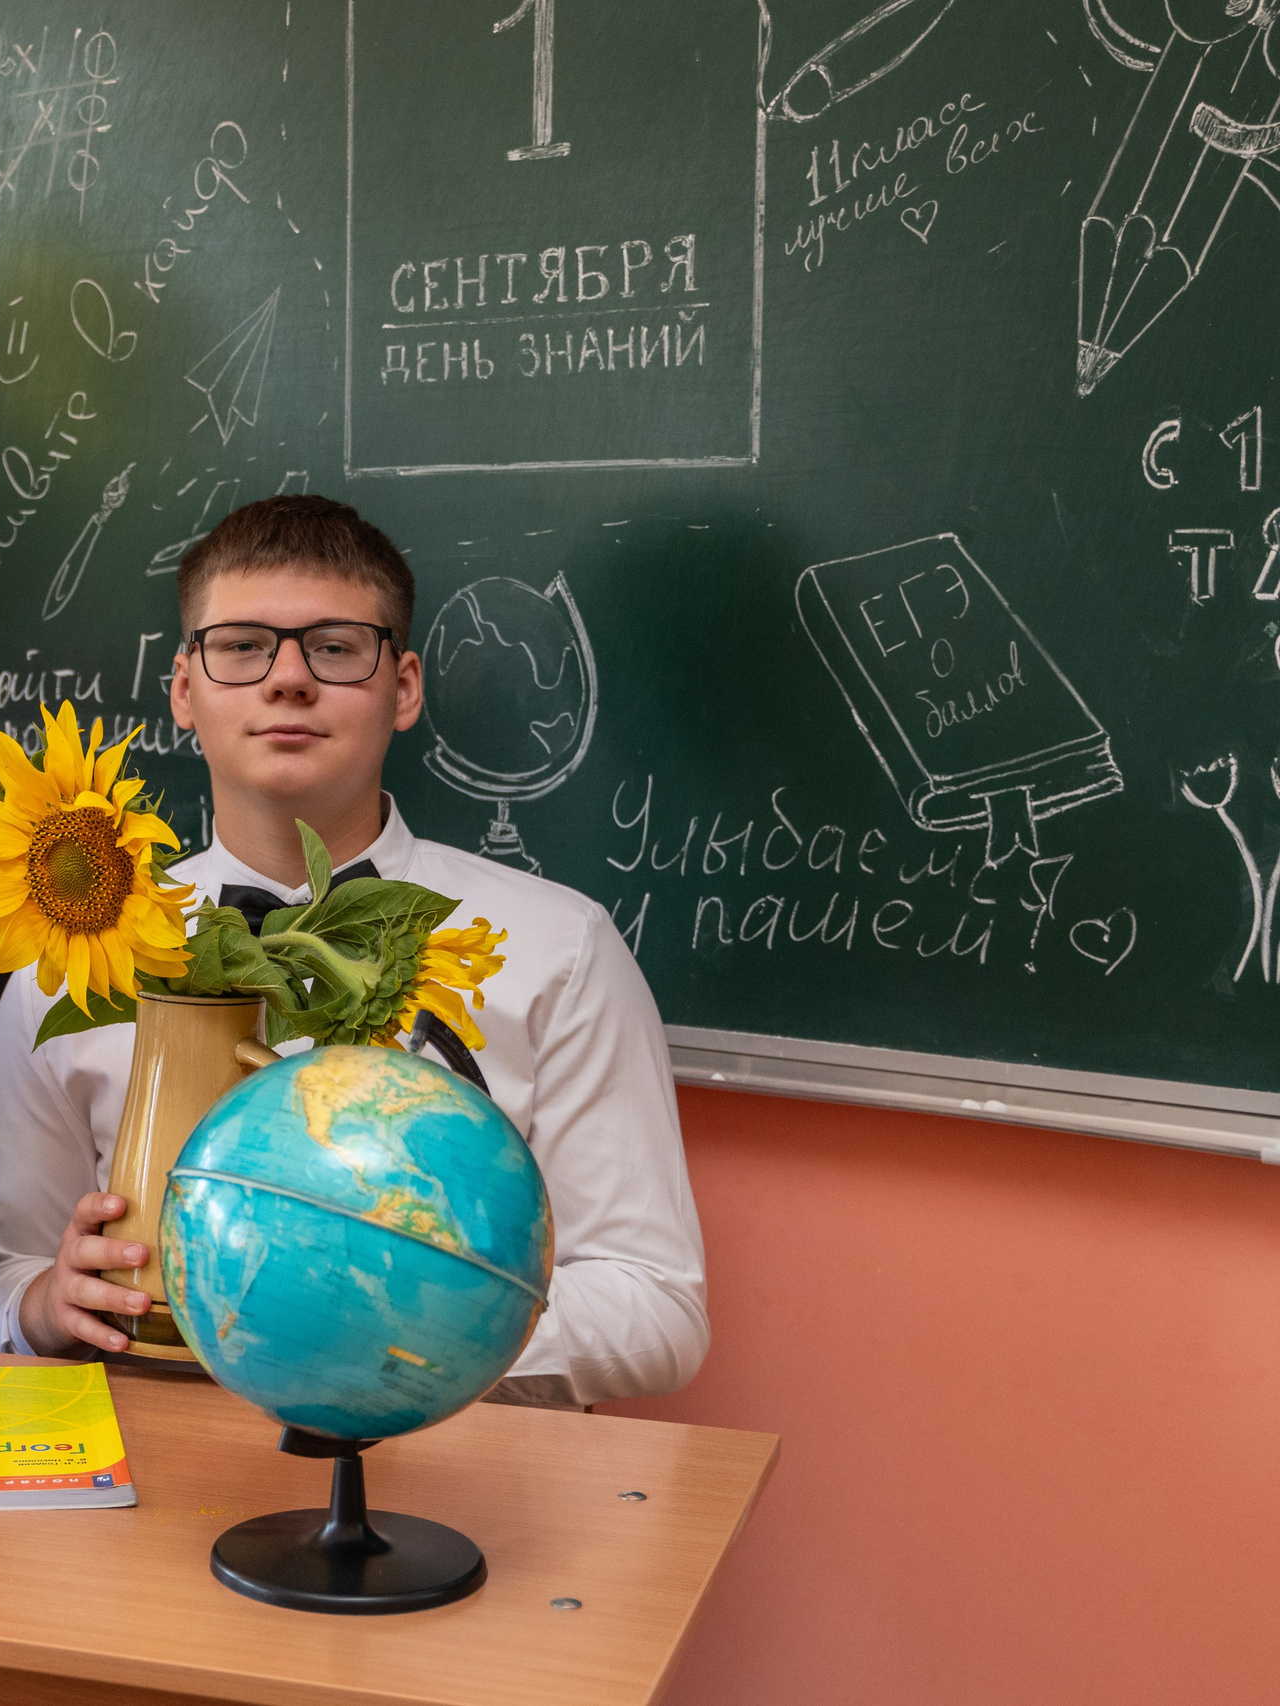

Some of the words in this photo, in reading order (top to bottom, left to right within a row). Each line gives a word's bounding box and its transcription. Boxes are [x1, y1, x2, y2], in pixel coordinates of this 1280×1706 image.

[493, 0, 571, 161] 1
[946, 113, 1045, 174] всех
[390, 233, 699, 314] СЕНТЯБРЯ
[380, 338, 495, 386] ДЕНЬ
[518, 310, 706, 378] ЗНАНИЙ
[1219, 405, 1262, 493] 1
[860, 564, 969, 657] ЕГЭ
[915, 641, 1027, 738] баллов
